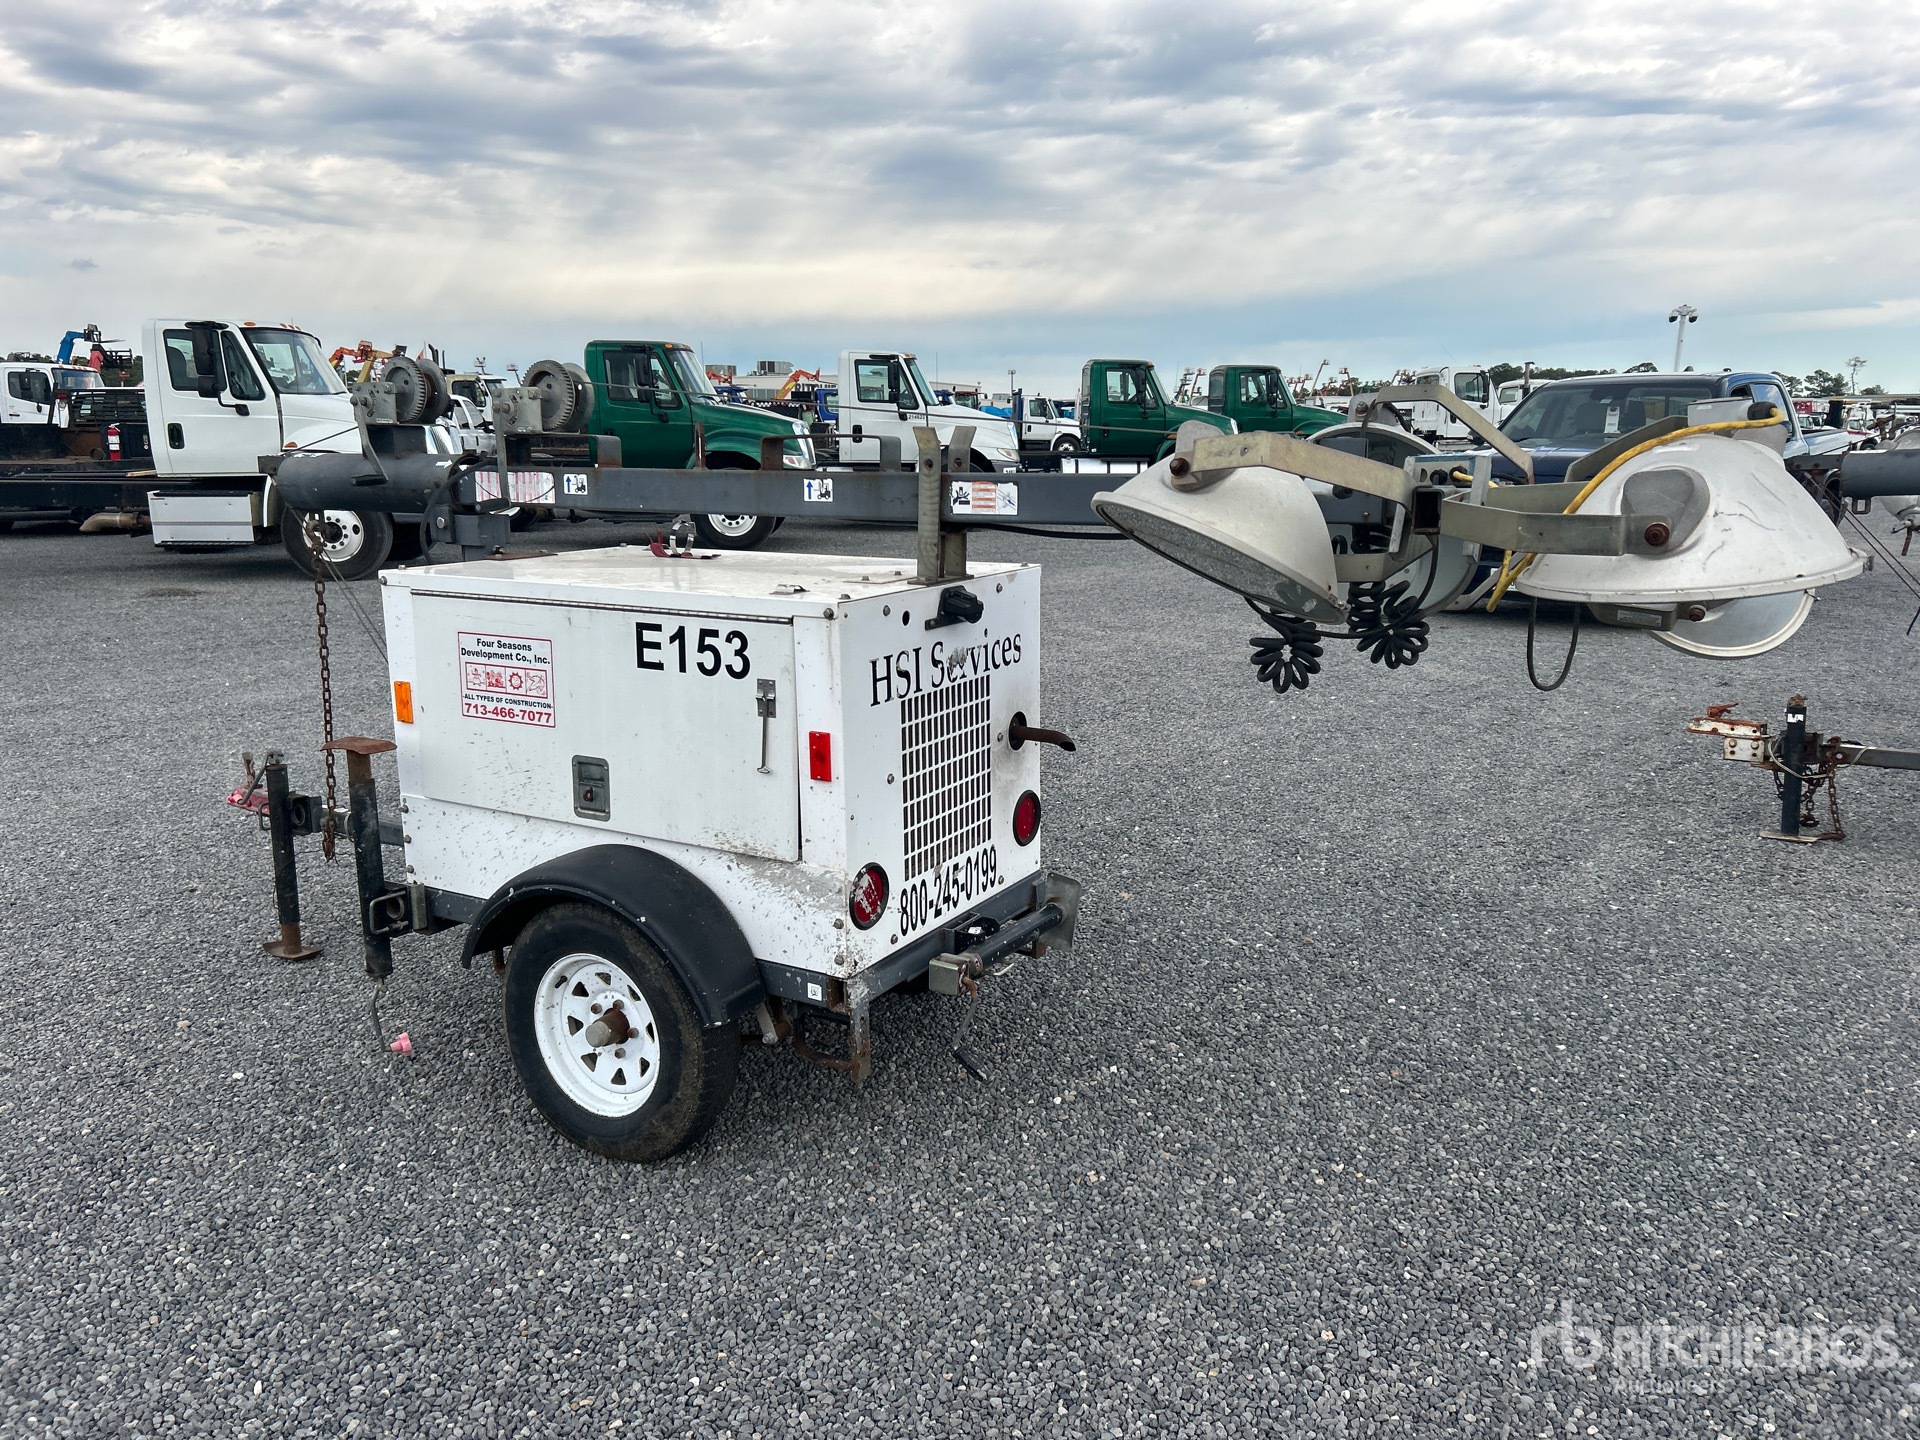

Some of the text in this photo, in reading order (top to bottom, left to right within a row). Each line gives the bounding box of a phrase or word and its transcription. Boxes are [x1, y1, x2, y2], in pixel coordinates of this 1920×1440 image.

[476, 638, 533, 652] Four Seasons
[635, 622, 751, 680] E153
[461, 647, 551, 665] Development Co., Inc.
[868, 647, 923, 707] HSI
[476, 694, 495, 703] TYPES
[464, 703, 552, 724] 713-466-7077
[900, 845, 997, 937] 800-245-0199
